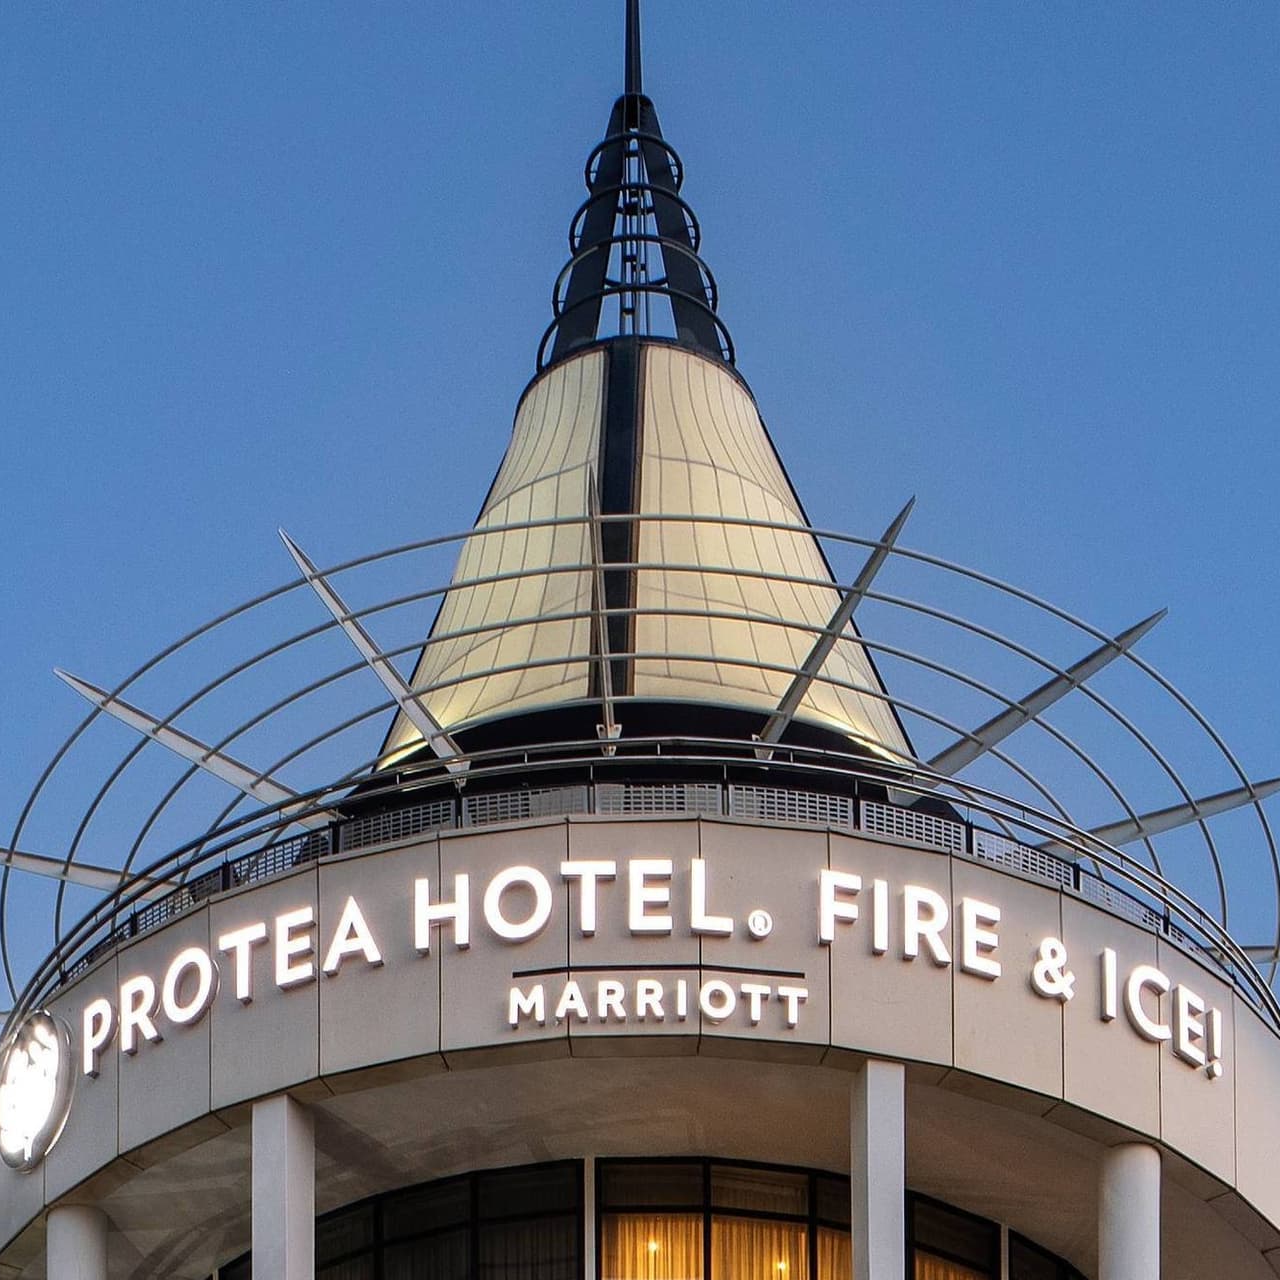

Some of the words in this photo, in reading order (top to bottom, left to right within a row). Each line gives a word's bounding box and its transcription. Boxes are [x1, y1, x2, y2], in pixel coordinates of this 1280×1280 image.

[82, 895, 384, 1078] PROTEA
[818, 869, 1002, 981] FIRE
[1030, 937, 1075, 1002] &
[1100, 948, 1223, 1081] ICE!
[508, 978, 809, 1028] MARRIOTT
